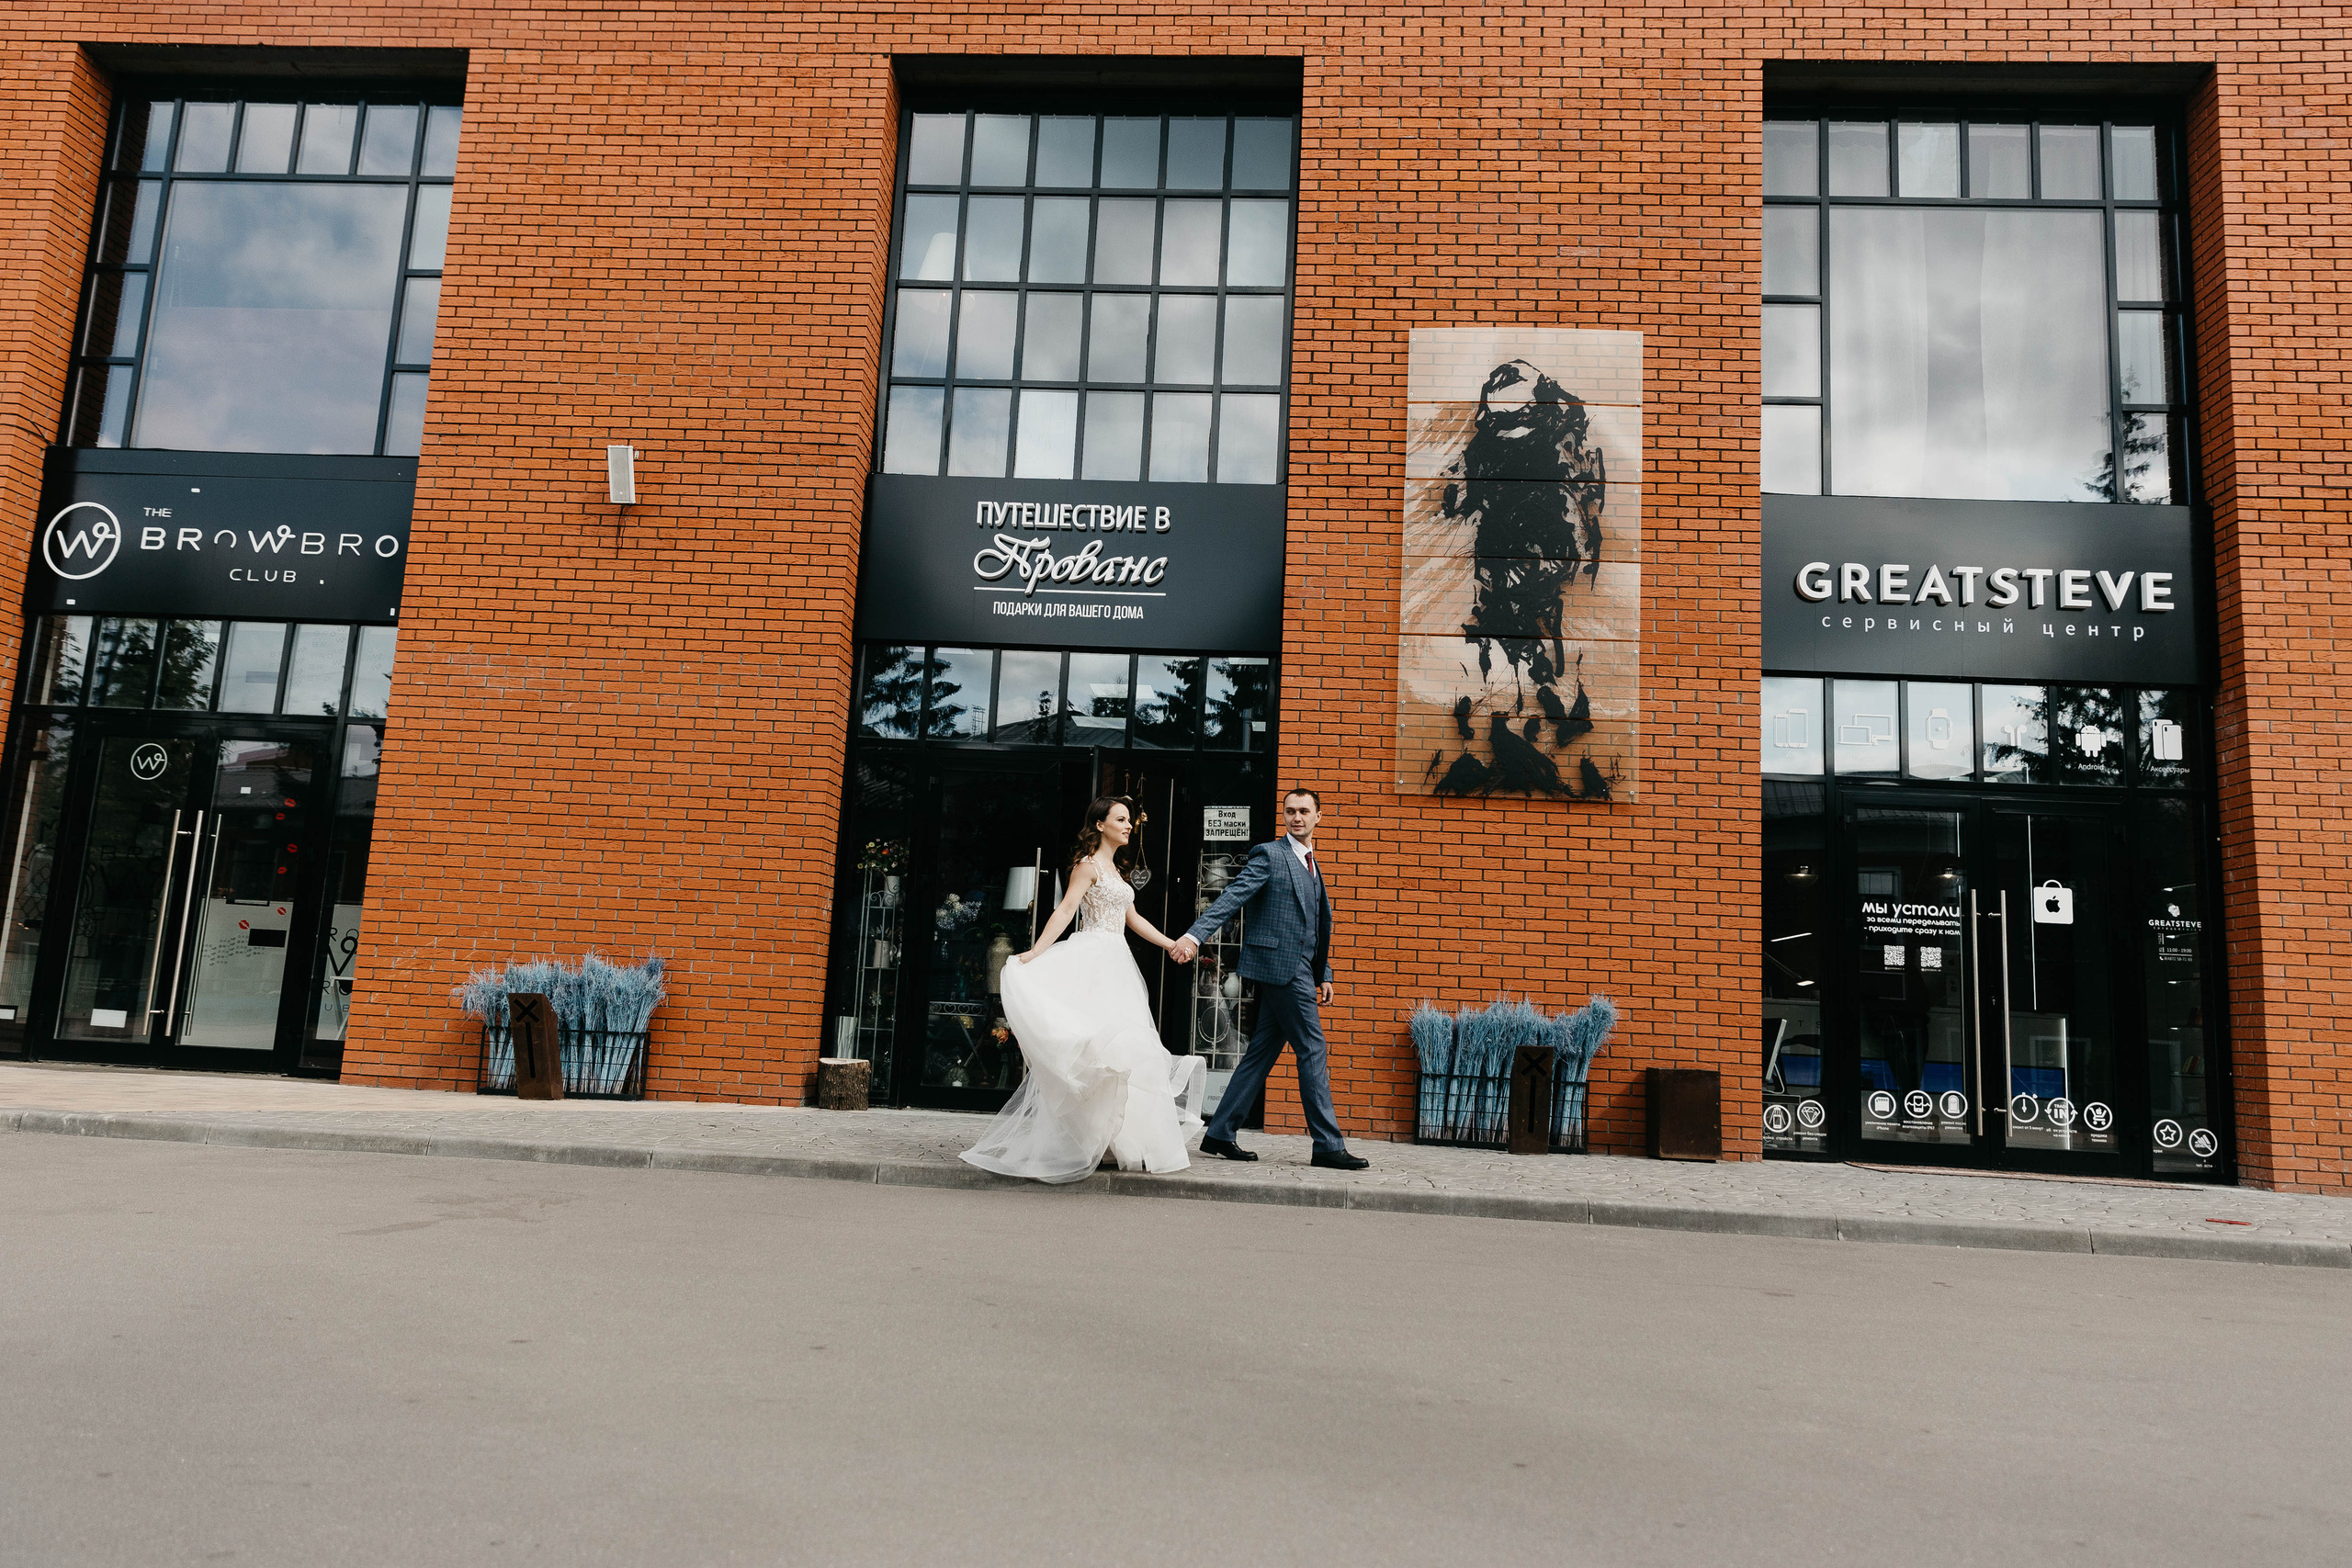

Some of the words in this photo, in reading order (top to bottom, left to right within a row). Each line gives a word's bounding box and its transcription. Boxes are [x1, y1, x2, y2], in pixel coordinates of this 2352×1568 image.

[143, 507, 172, 518] THE
[977, 501, 1147, 531] ПУТЕШЕСТВИЕ
[1155, 506, 1170, 532] В
[973, 533, 1169, 595] Прованс
[230, 569, 297, 583] CLUB
[1796, 561, 2175, 613] GREATSTEVE
[993, 601, 1042, 616] ПОДАРКИ
[1044, 602, 1066, 618] ДЛЯ
[1069, 604, 1112, 620] ВАШЕГО
[1113, 604, 1144, 620] ДОМА
[1822, 615, 2014, 635] сервисный
[2043, 622, 2145, 641] центр
[2150, 766, 2190, 775] Аксессуары
[1218, 810, 1236, 818] Вход
[1893, 904, 1960, 919] устали
[1903, 919, 1961, 927] переделывать
[2148, 919, 2201, 928] GREATSTEVE
[1869, 926, 1913, 934] приходите
[1915, 928, 1937, 936] сразу
